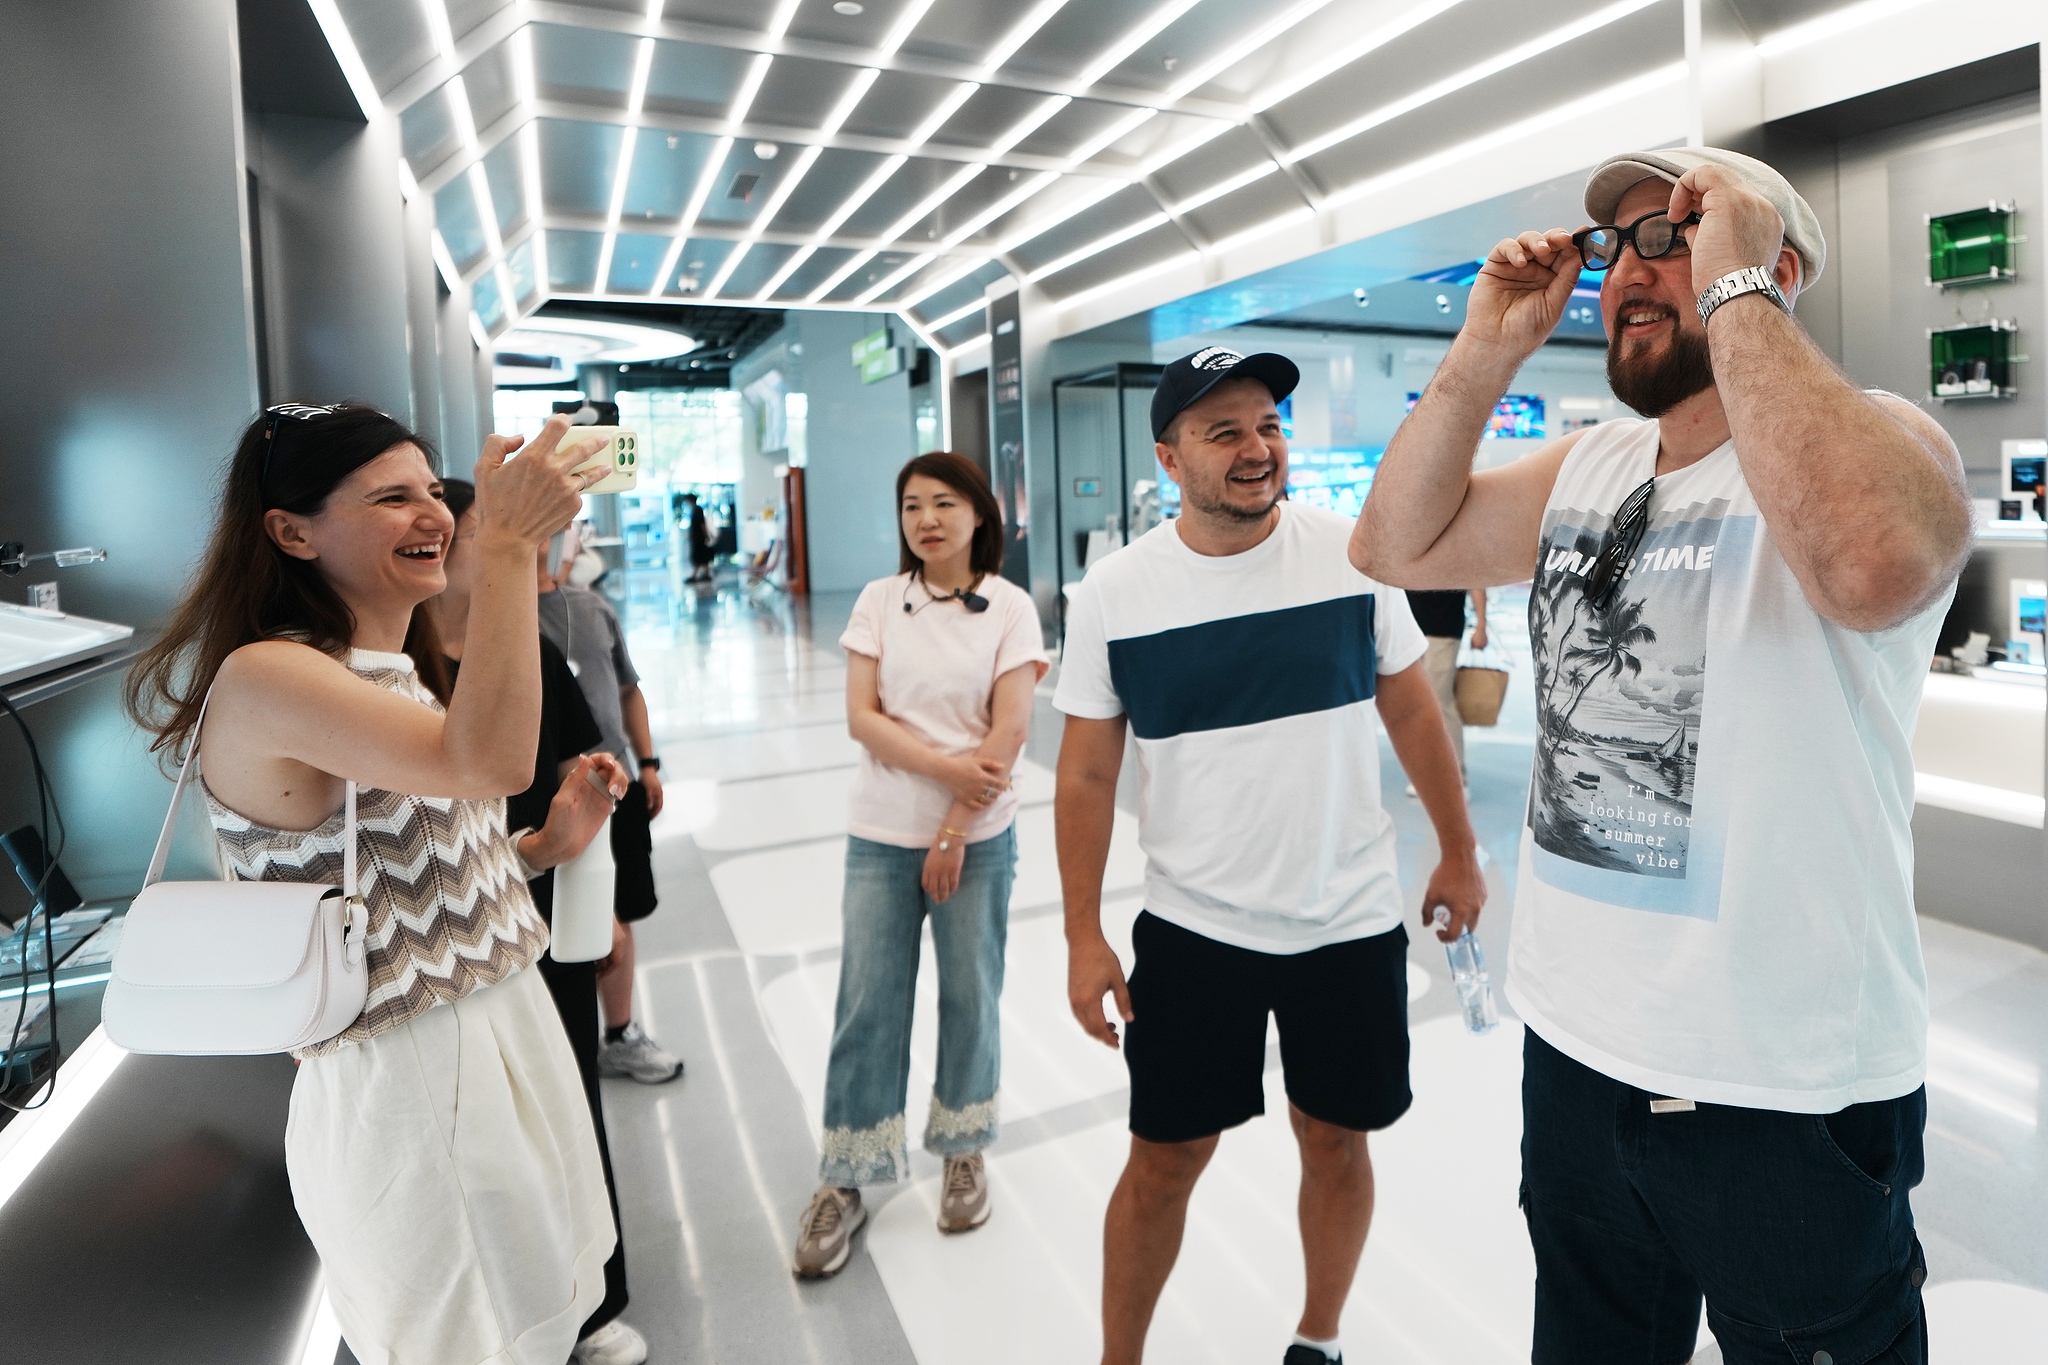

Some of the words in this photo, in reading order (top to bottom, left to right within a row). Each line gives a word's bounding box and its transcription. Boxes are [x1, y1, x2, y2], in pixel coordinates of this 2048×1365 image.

[1640, 544, 1715, 574] TIME
[1588, 801, 1657, 828] looking
[1662, 811, 1695, 828] for
[1583, 823, 1591, 835] a
[1604, 828, 1666, 848] summer
[1636, 851, 1680, 869] vibe
